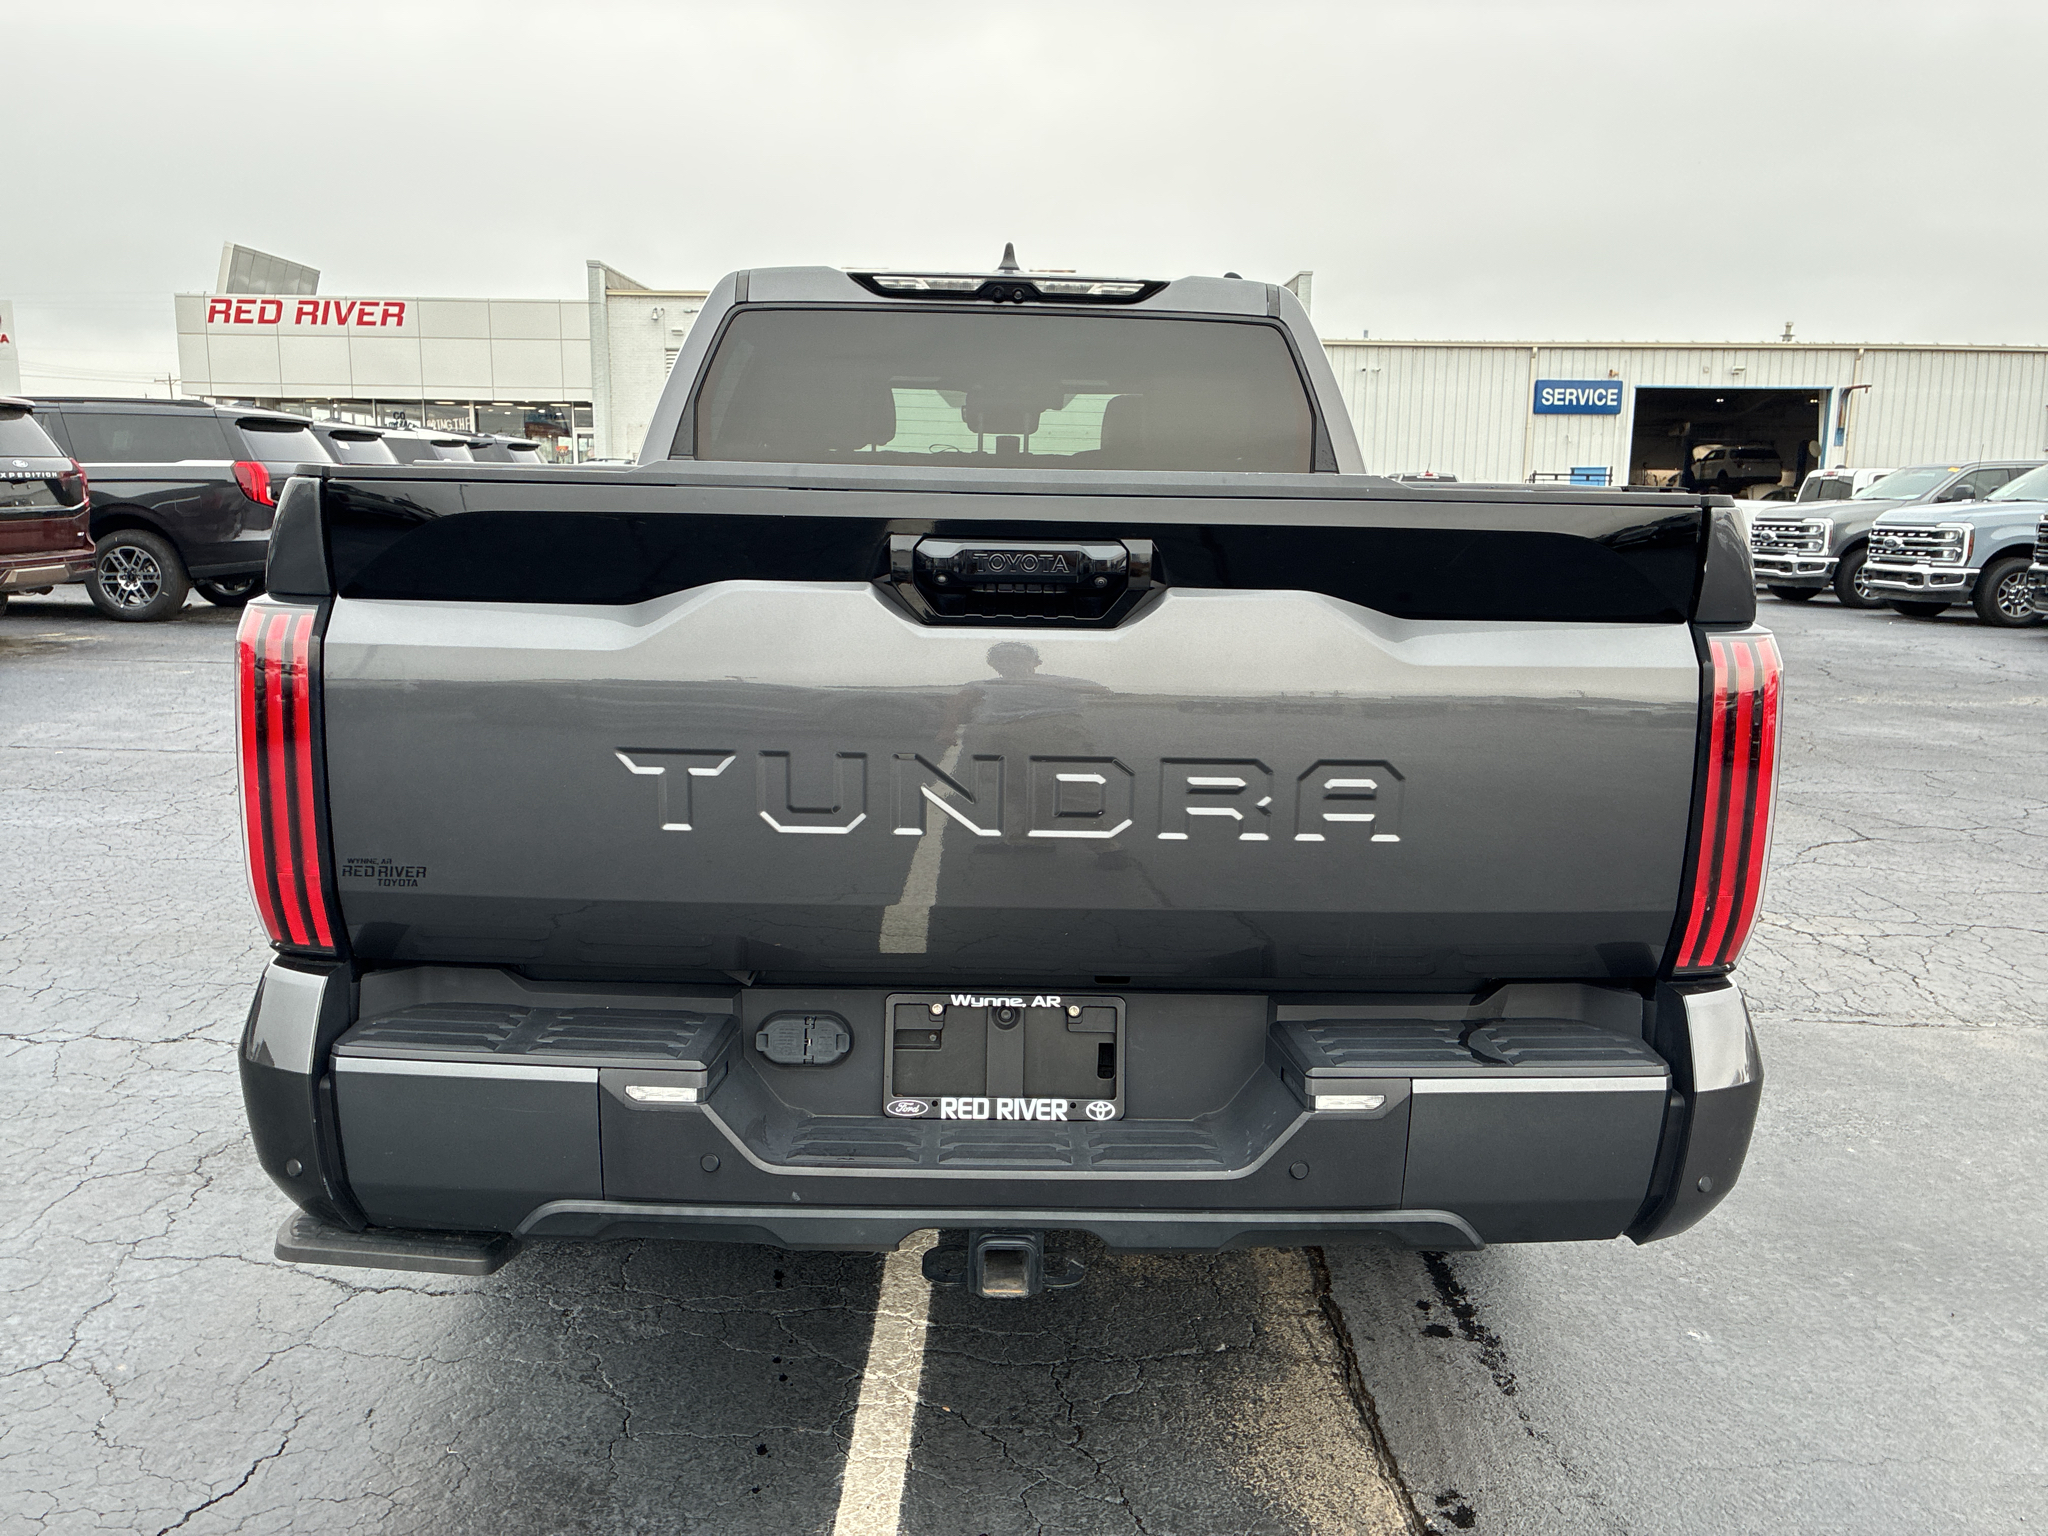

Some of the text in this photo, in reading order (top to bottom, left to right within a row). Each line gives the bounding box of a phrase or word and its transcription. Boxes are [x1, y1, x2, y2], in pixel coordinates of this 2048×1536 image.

[207, 298, 406, 327] RED RIVER
[1541, 387, 1619, 406] SERVICE
[0, 471, 58, 479] XPEDITION
[973, 553, 1070, 573] TOYOTA
[615, 746, 1405, 842] TUNDRA
[342, 864, 428, 878] RED RIVER
[377, 878, 419, 888] TOYOTA
[950, 994, 1061, 1008] Wynne, AR
[940, 1097, 1068, 1121] RED RIVER
